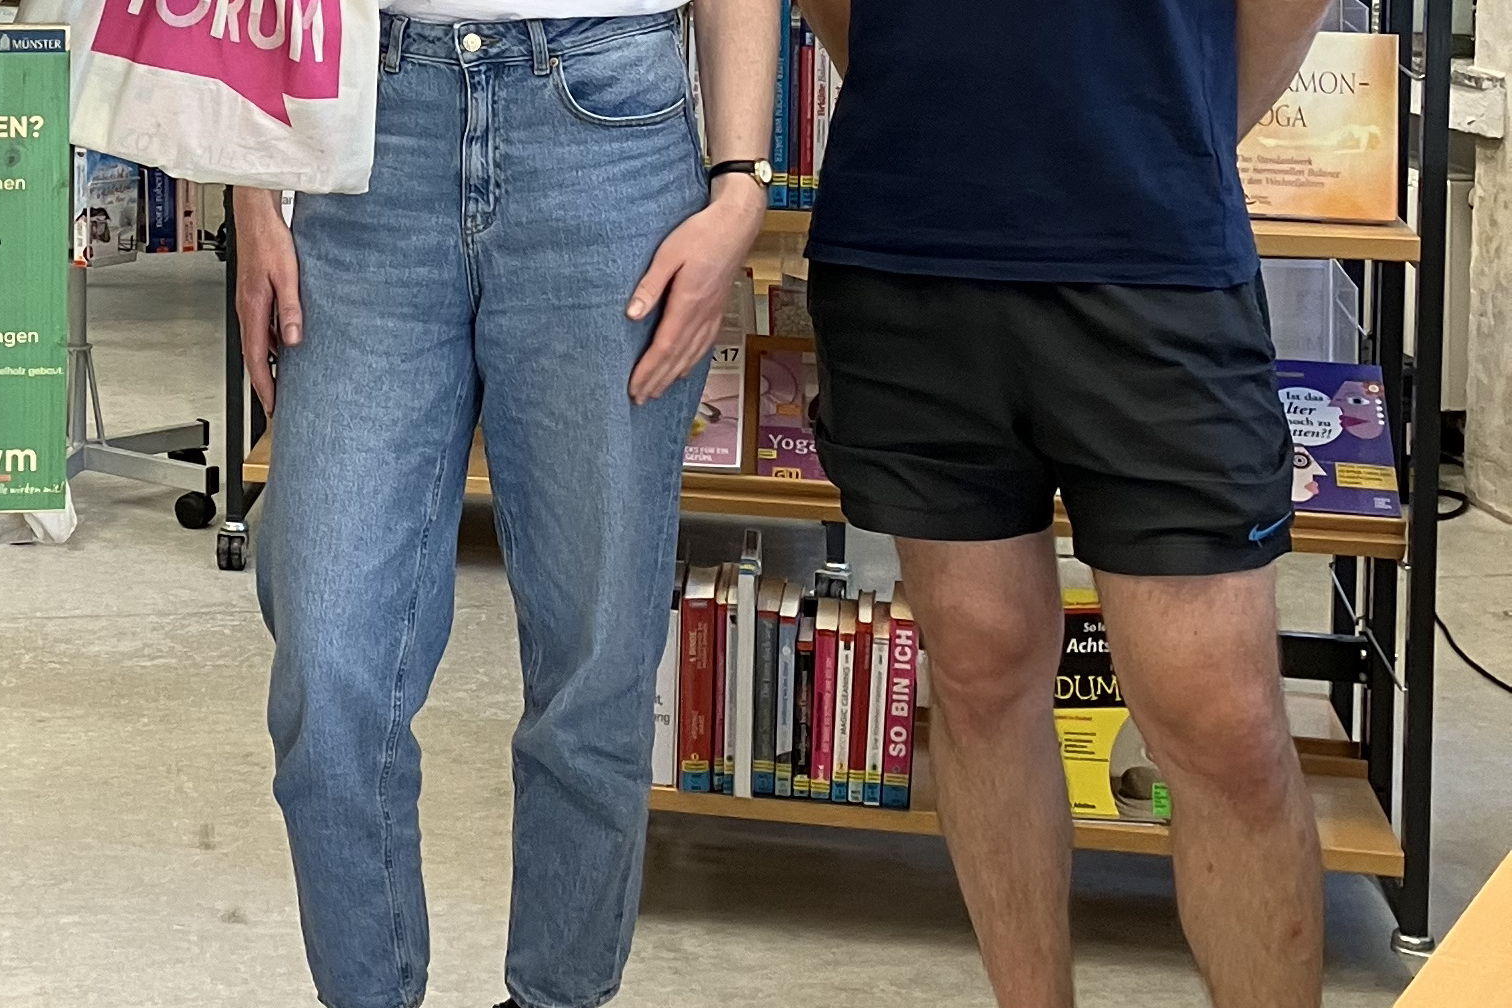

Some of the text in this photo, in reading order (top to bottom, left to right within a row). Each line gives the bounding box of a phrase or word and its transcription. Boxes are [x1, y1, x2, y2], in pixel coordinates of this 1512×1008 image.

[12, 37, 61, 49] MÜNSTER
[1288, 71, 1370, 94] MON-
[28, 367, 65, 378] gebaut.
[1304, 392, 1323, 402] das
[9, 482, 41, 494] wirken
[1083, 622, 1097, 632] So
[888, 629, 913, 757] SO BIN ICH
[839, 667, 850, 736] MAGIC CLEANING
